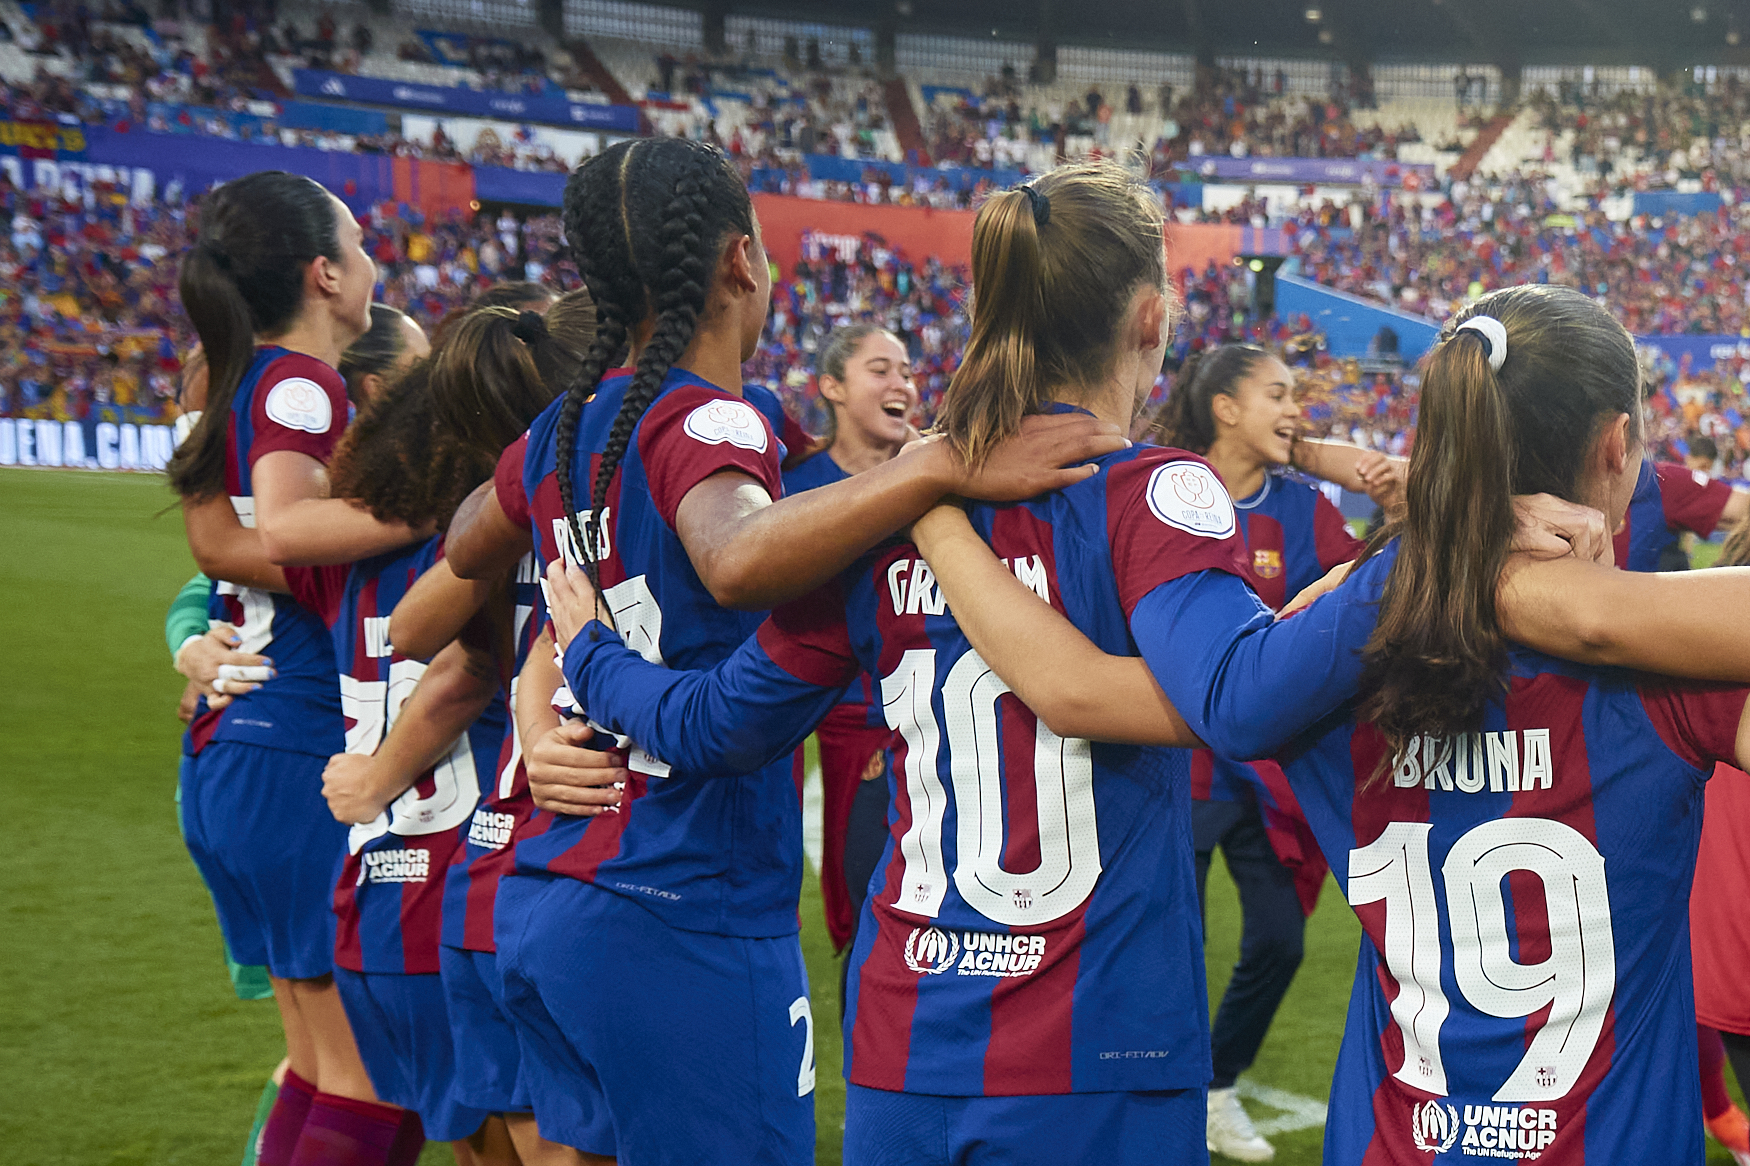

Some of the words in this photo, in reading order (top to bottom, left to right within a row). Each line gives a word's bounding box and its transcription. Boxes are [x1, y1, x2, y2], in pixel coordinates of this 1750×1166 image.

[1182, 510, 1200, 519] COPA
[887, 554, 1050, 616] GRM
[1393, 728, 1553, 793] BRUNA
[880, 649, 1103, 926] 10
[365, 849, 430, 867] UNHCR
[369, 863, 430, 878] ACNUR
[963, 932, 1047, 955] UNHCR
[958, 951, 1042, 971] ACNUR
[1348, 817, 1616, 1103] 19
[788, 996, 816, 1098] 2
[1463, 1105, 1558, 1130] UNHCR
[1462, 1147, 1476, 1156] The
[1477, 1148, 1490, 1157] UN
[1490, 1149, 1524, 1160] Refugee
[1525, 1150, 1542, 1161] Age
